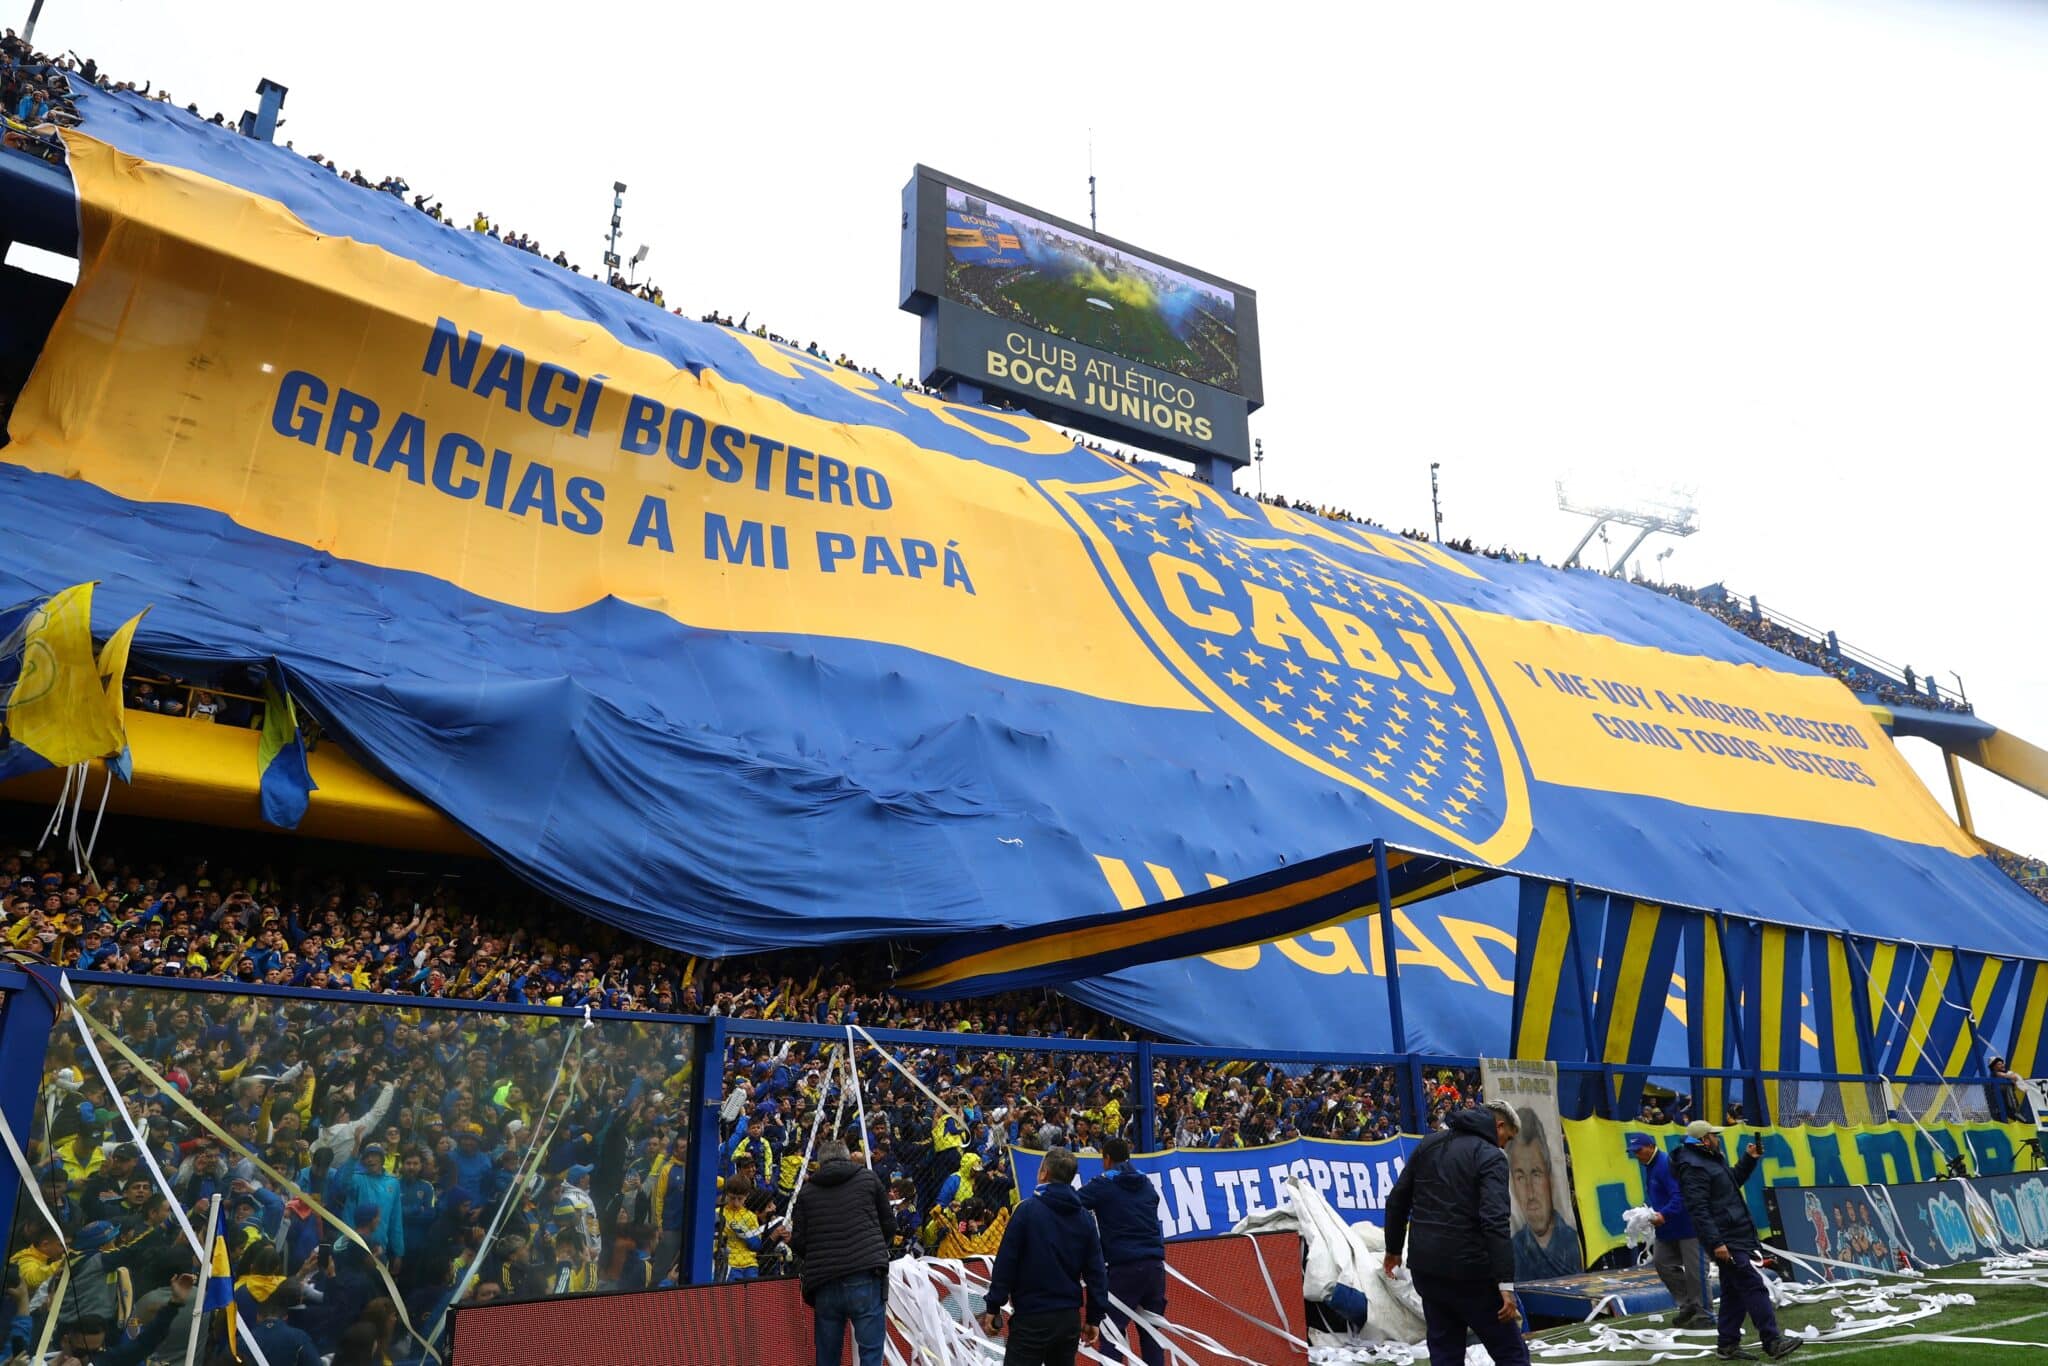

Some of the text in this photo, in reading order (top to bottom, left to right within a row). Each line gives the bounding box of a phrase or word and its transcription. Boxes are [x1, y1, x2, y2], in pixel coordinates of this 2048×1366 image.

[421, 317, 893, 511] NACÍ BOSTERO
[987, 350, 1213, 441] BOCA JUNIORS
[1006, 332, 1195, 410] CLUB ATLÉTICO
[271, 370, 976, 597] GRACIAS A MI PAPÁ
[1148, 551, 1457, 696] CABJ
[1513, 660, 1869, 750] Y ME VOY A MORIR BOSTERO
[1592, 712, 1876, 787] COMO TODOS USTEDES
[1214, 1168, 1268, 1223] TE
[1269, 1156, 1405, 1210] EPERA
[1597, 1126, 2014, 1237] JGADOR
